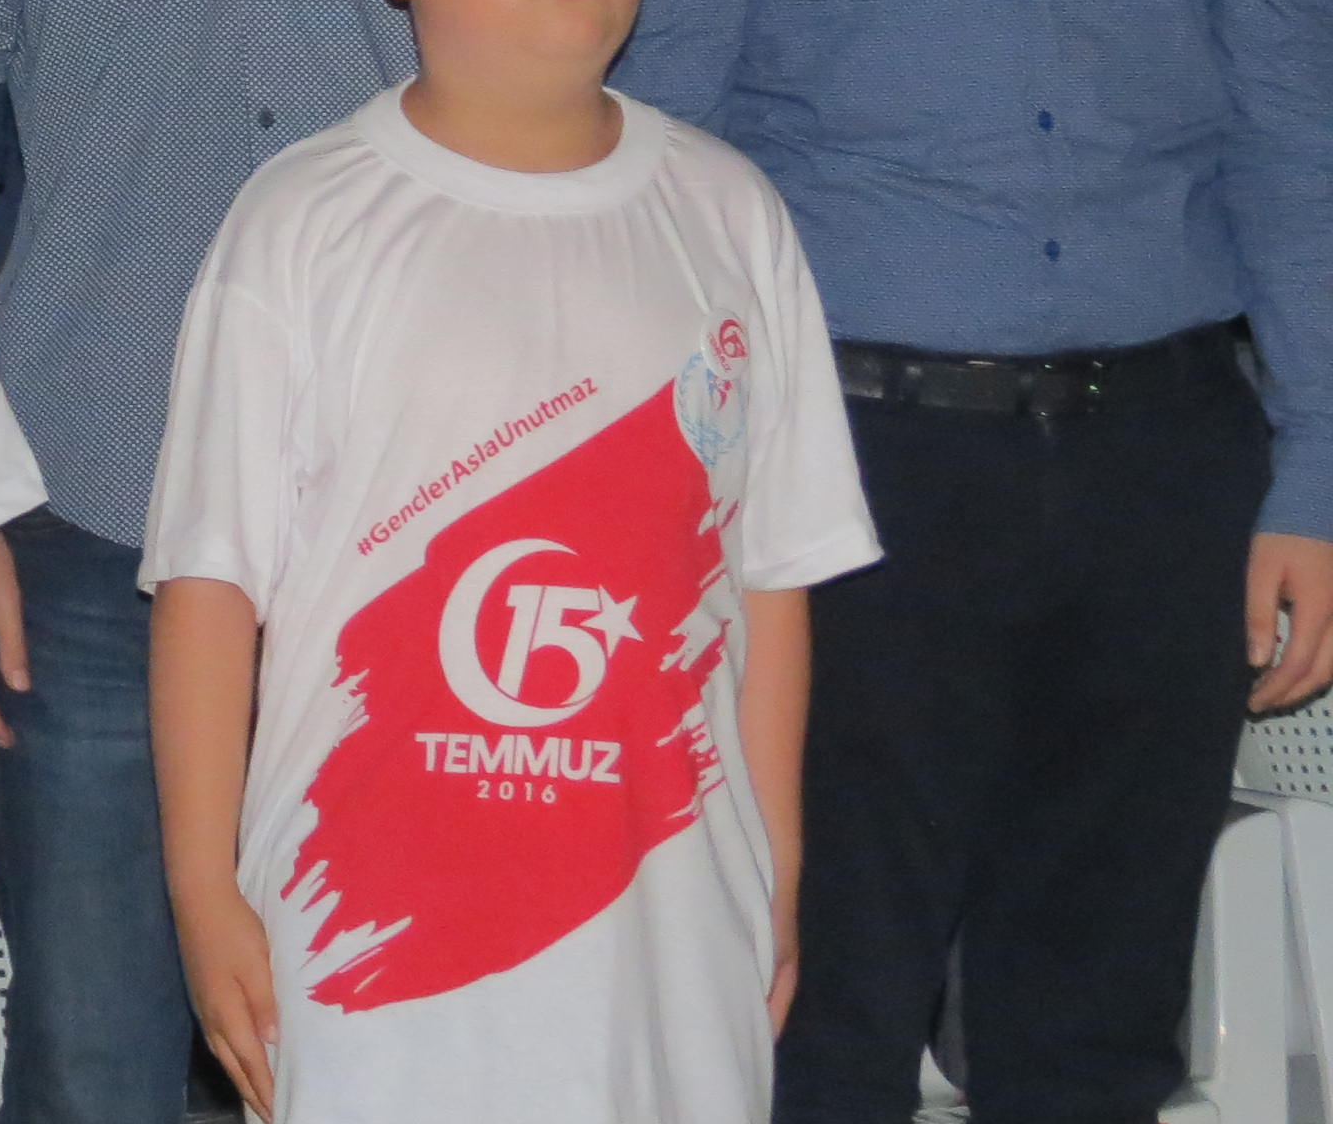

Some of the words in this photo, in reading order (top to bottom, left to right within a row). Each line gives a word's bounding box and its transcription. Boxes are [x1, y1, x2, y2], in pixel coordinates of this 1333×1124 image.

[357, 377, 599, 557] #GenclerAslaUnutmaz
[497, 584, 608, 707] 15
[415, 732, 621, 783] TEMMUZ
[476, 779, 558, 804] 2016
